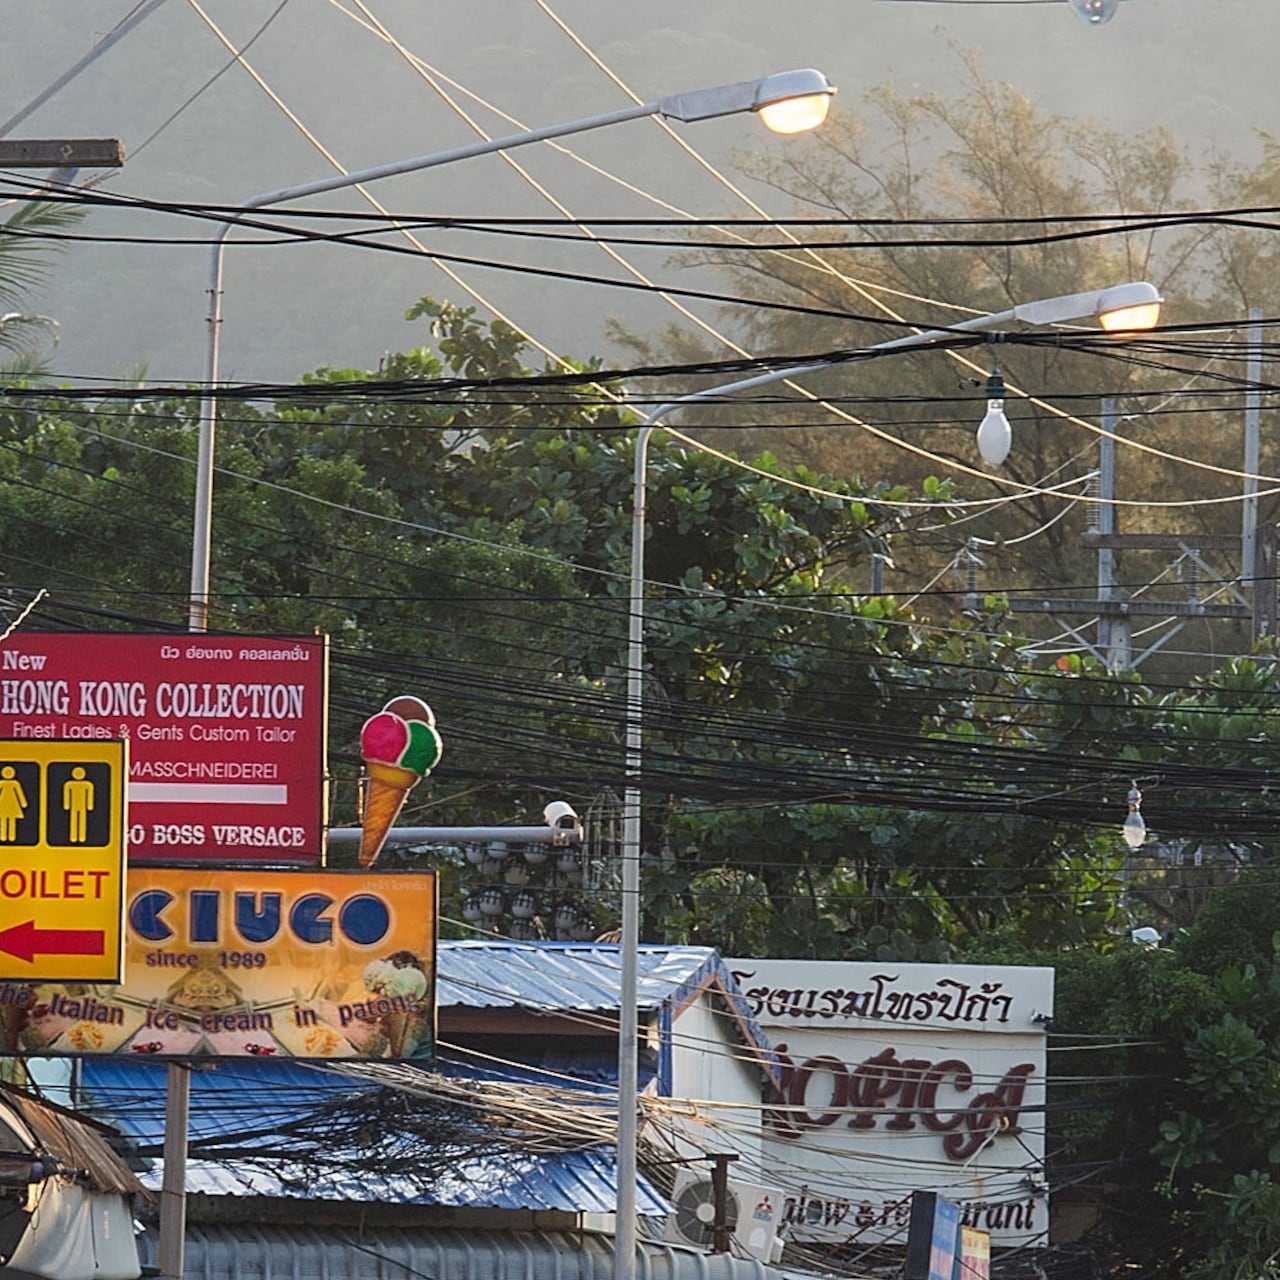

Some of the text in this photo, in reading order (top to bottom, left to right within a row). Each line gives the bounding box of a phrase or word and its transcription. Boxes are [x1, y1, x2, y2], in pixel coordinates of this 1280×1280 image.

[2, 650, 47, 671] New
[1, 679, 305, 720] HONG KONG COLLECTION
[13, 721, 56, 738] Finest
[62, 721, 112, 739] Ladies
[137, 724, 184, 742] Gents
[189, 724, 249, 742] Custom
[256, 726, 297, 743] Tailor
[152, 824, 205, 845] BOSS
[212, 825, 306, 847] VERSACE
[146, 949, 266, 969] since 1989
[50, 991, 125, 1025] Italian
[145, 1007, 178, 1030] ice
[199, 1009, 273, 1033] cream
[294, 1004, 317, 1027] in
[339, 991, 420, 1026] patong
